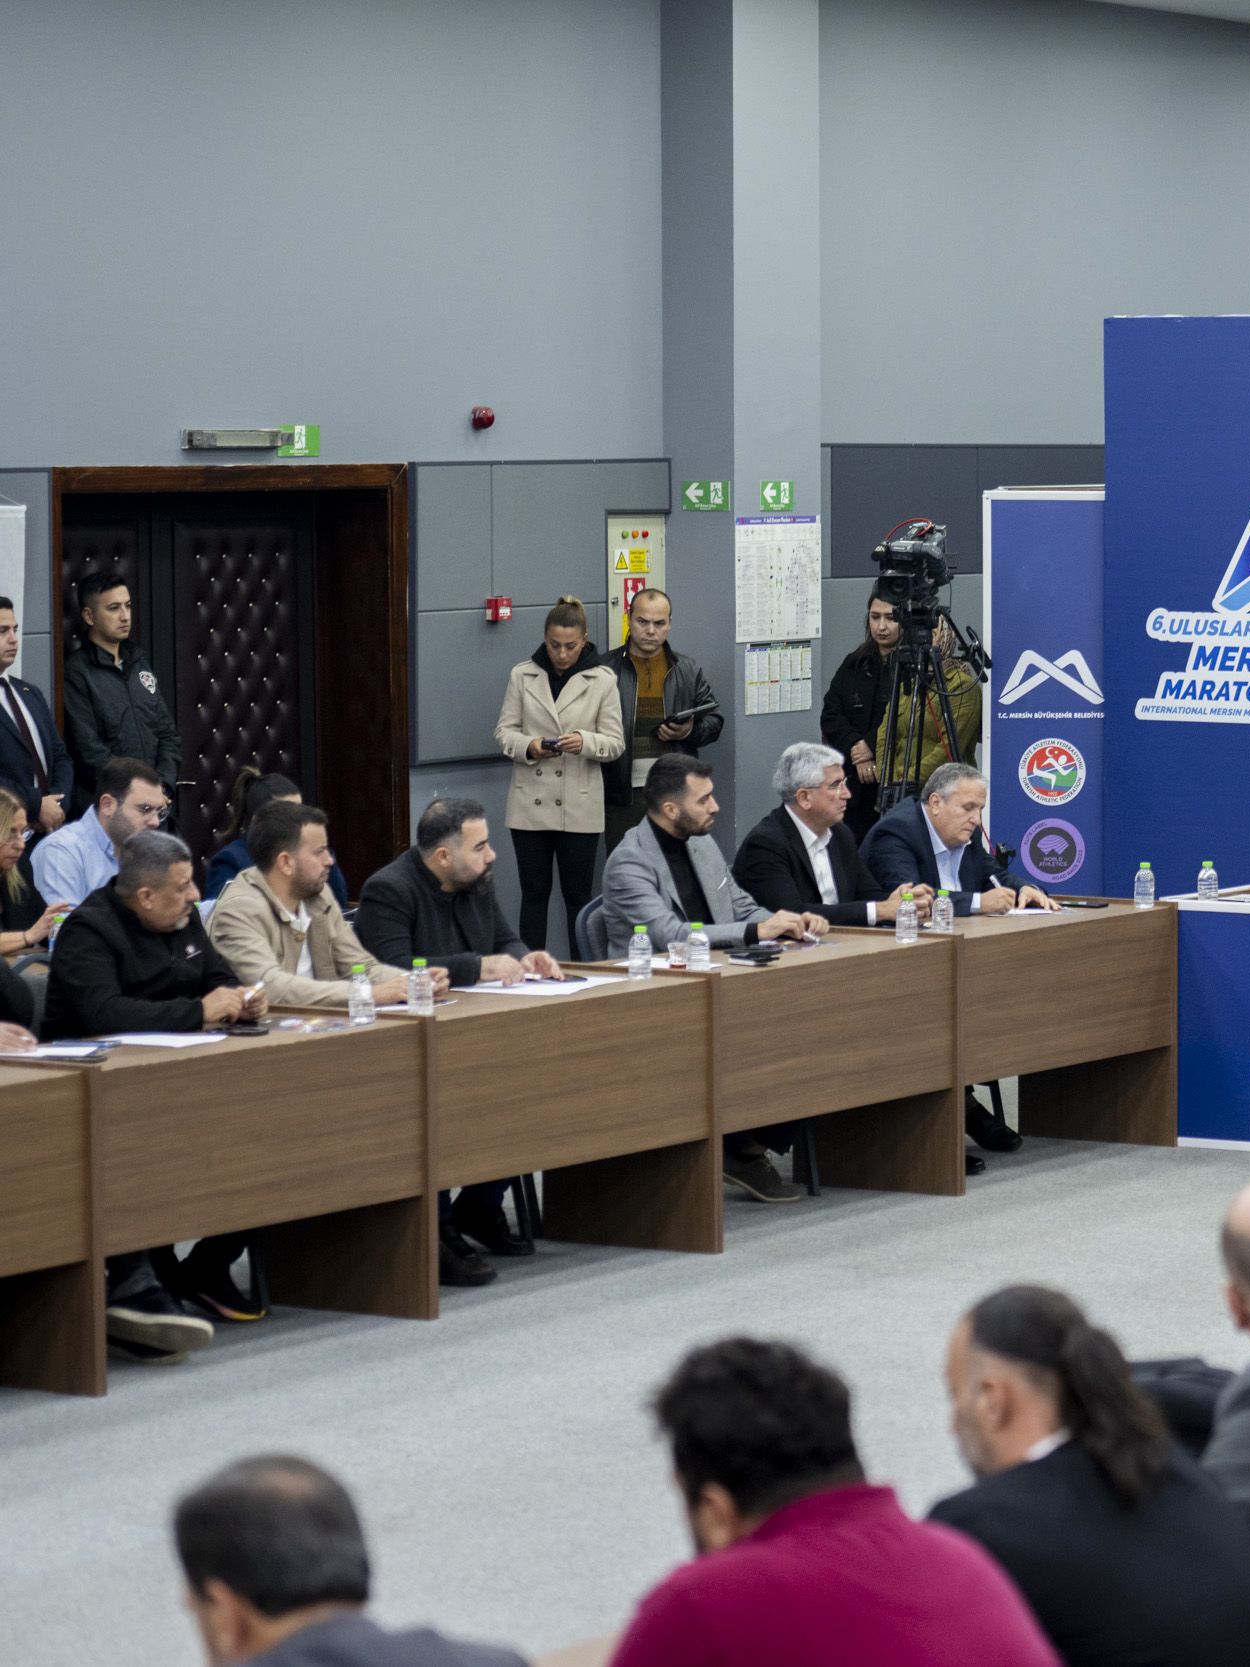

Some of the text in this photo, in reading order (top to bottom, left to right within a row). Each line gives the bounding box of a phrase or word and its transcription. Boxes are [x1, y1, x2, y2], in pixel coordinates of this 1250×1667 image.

[1009, 711, 1033, 719] MERSİN
[1034, 711, 1073, 720] BÜYÜKŞEHİR
[1073, 711, 1105, 719] BELEDİYES
[1141, 705, 1208, 715] INTERNATIONAL
[1209, 707, 1243, 717] MERSIN
